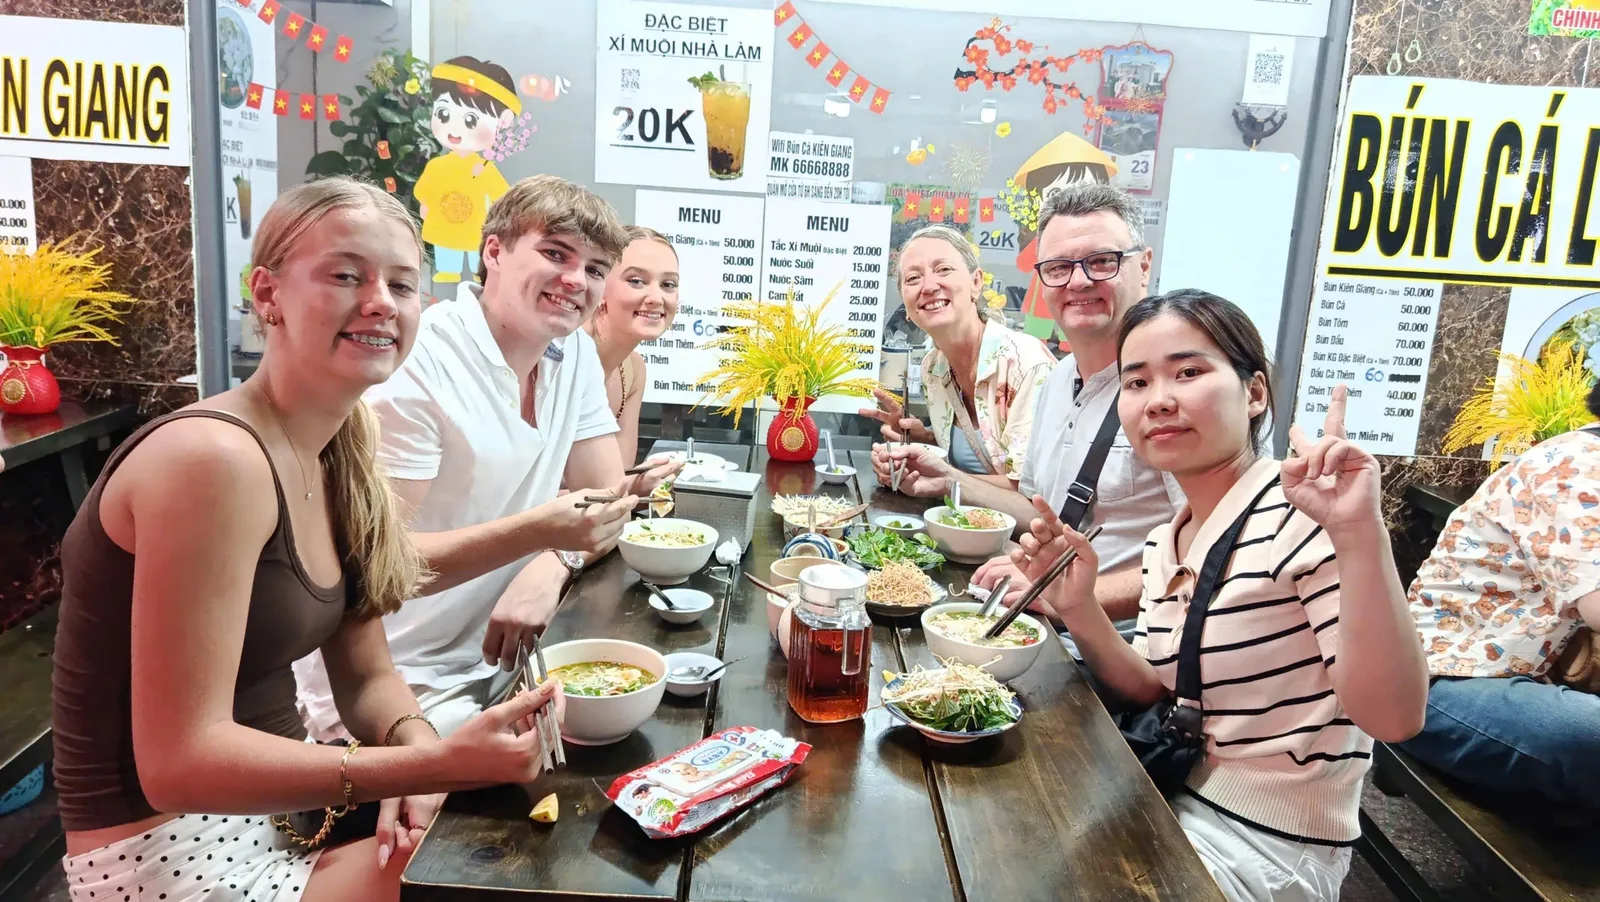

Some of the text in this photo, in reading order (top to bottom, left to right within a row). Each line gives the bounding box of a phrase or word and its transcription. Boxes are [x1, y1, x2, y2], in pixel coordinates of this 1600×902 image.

[644, 13, 728, 35] ĐẶC BIỆT
[609, 34, 761, 60] XÍ MUỘI NHÀ LÀM
[43, 59, 170, 143] GIANG
[613, 106, 696, 145] 20K
[772, 139, 785, 153] Wifi
[831, 144, 852, 159] GIANG
[770, 156, 850, 177] MK 66668888
[1131, 160, 1149, 174] 23
[1333, 85, 1470, 259] BÚN
[1475, 93, 1565, 263] CÁ
[678, 207, 721, 224] MENU
[807, 215, 849, 232] MENU
[675, 234, 696, 246] Giang
[724, 238, 755, 249] 50.000
[771, 239, 786, 251] Tắc
[800, 242, 821, 255] Muội
[853, 246, 882, 256] 20.000
[723, 255, 754, 266] 50.000
[770, 257, 792, 268] Nước
[853, 262, 881, 273] 15.000
[722, 273, 753, 284] 60.000
[769, 274, 879, 289] Nước Sâm 20.000
[768, 290, 788, 301] Cam
[849, 295, 878, 306] 25.000
[1324, 282, 1337, 291] Bún
[1338, 283, 1354, 293] Kiên
[1356, 284, 1375, 295] Giang
[1403, 286, 1434, 298] 50.000
[680, 305, 694, 317] Biệt
[1321, 299, 1431, 315] Bún Cá 50.000
[848, 312, 877, 322] 20.000
[1318, 317, 1428, 333] Bún Tôm 60.000
[693, 320, 715, 336] 60
[659, 338, 674, 348] Tôm
[676, 339, 694, 349] Thêm
[1316, 334, 1329, 345] Bún
[1395, 339, 1425, 350] 70.000
[650, 354, 669, 364] Thêm
[1313, 352, 1326, 361] Bún
[1352, 354, 1366, 365] Biệt
[1392, 356, 1422, 367] 70.000
[1325, 369, 1335, 379] Cá
[1337, 370, 1355, 380] Thêm
[1365, 367, 1384, 382] 60
[654, 380, 669, 390] Bún
[1346, 387, 1417, 400] hêm 40.000
[1305, 403, 1414, 417] Cá Thê 35.000
[1358, 430, 1379, 441] Miễn
